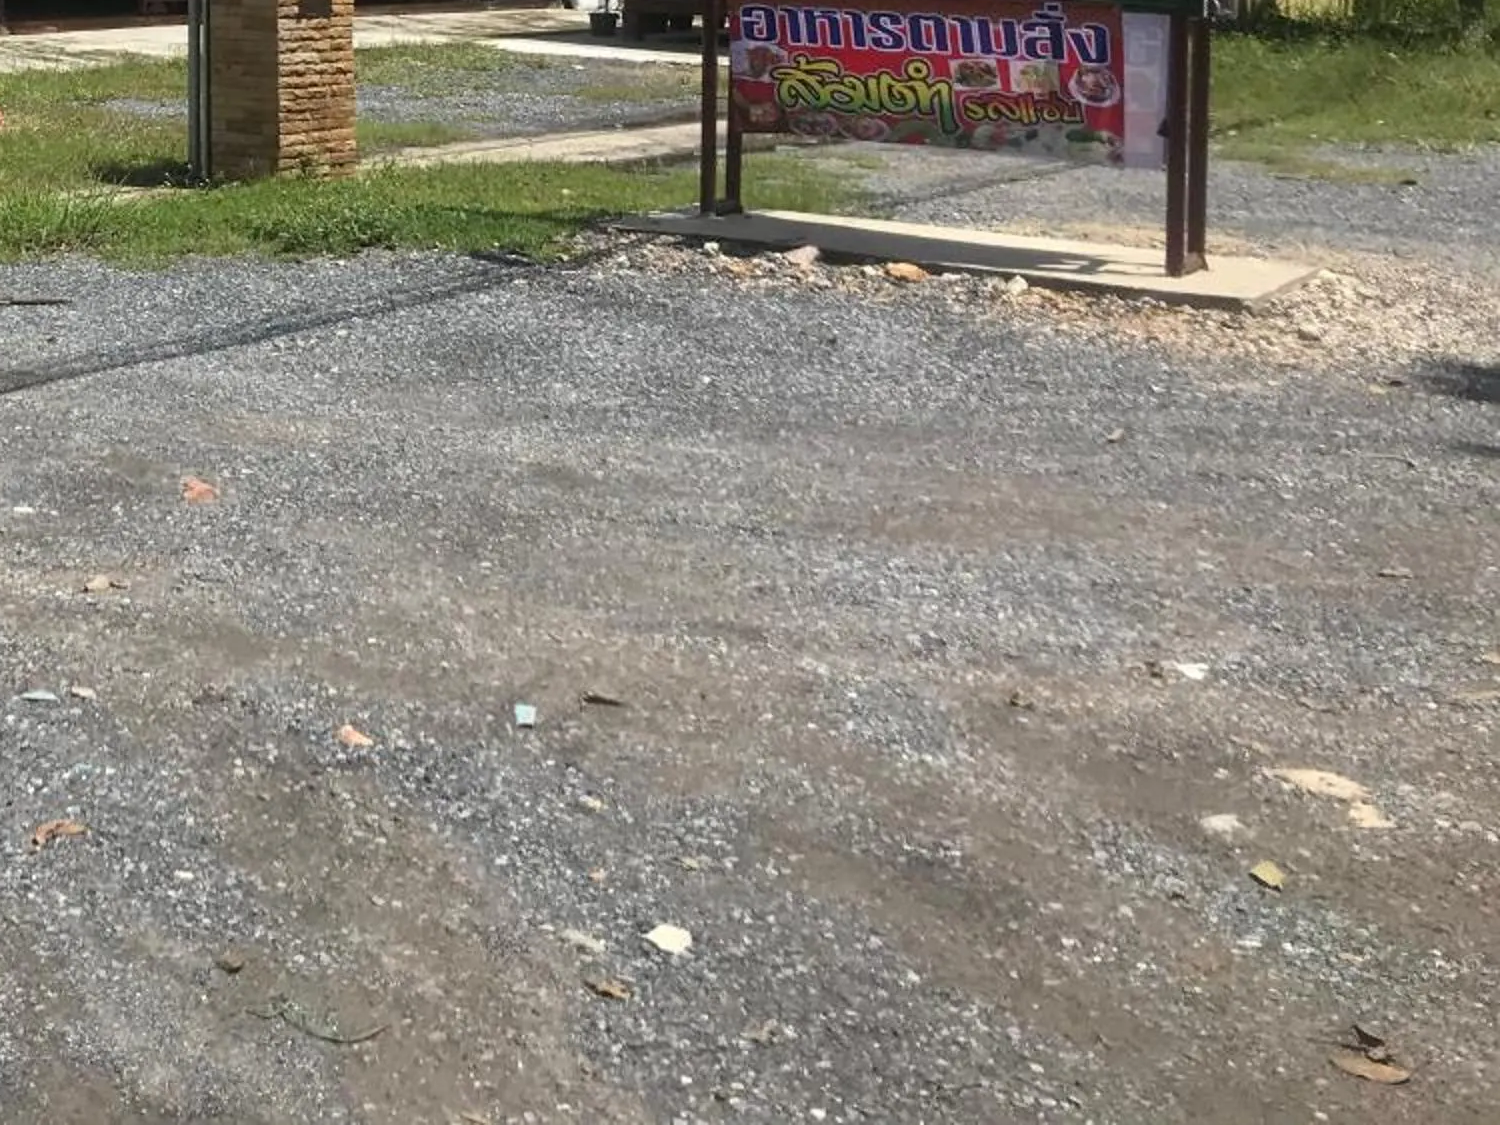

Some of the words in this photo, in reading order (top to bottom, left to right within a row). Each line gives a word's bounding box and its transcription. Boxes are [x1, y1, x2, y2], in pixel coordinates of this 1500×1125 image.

[739, 2, 1111, 64] อาหารตามสั่ง
